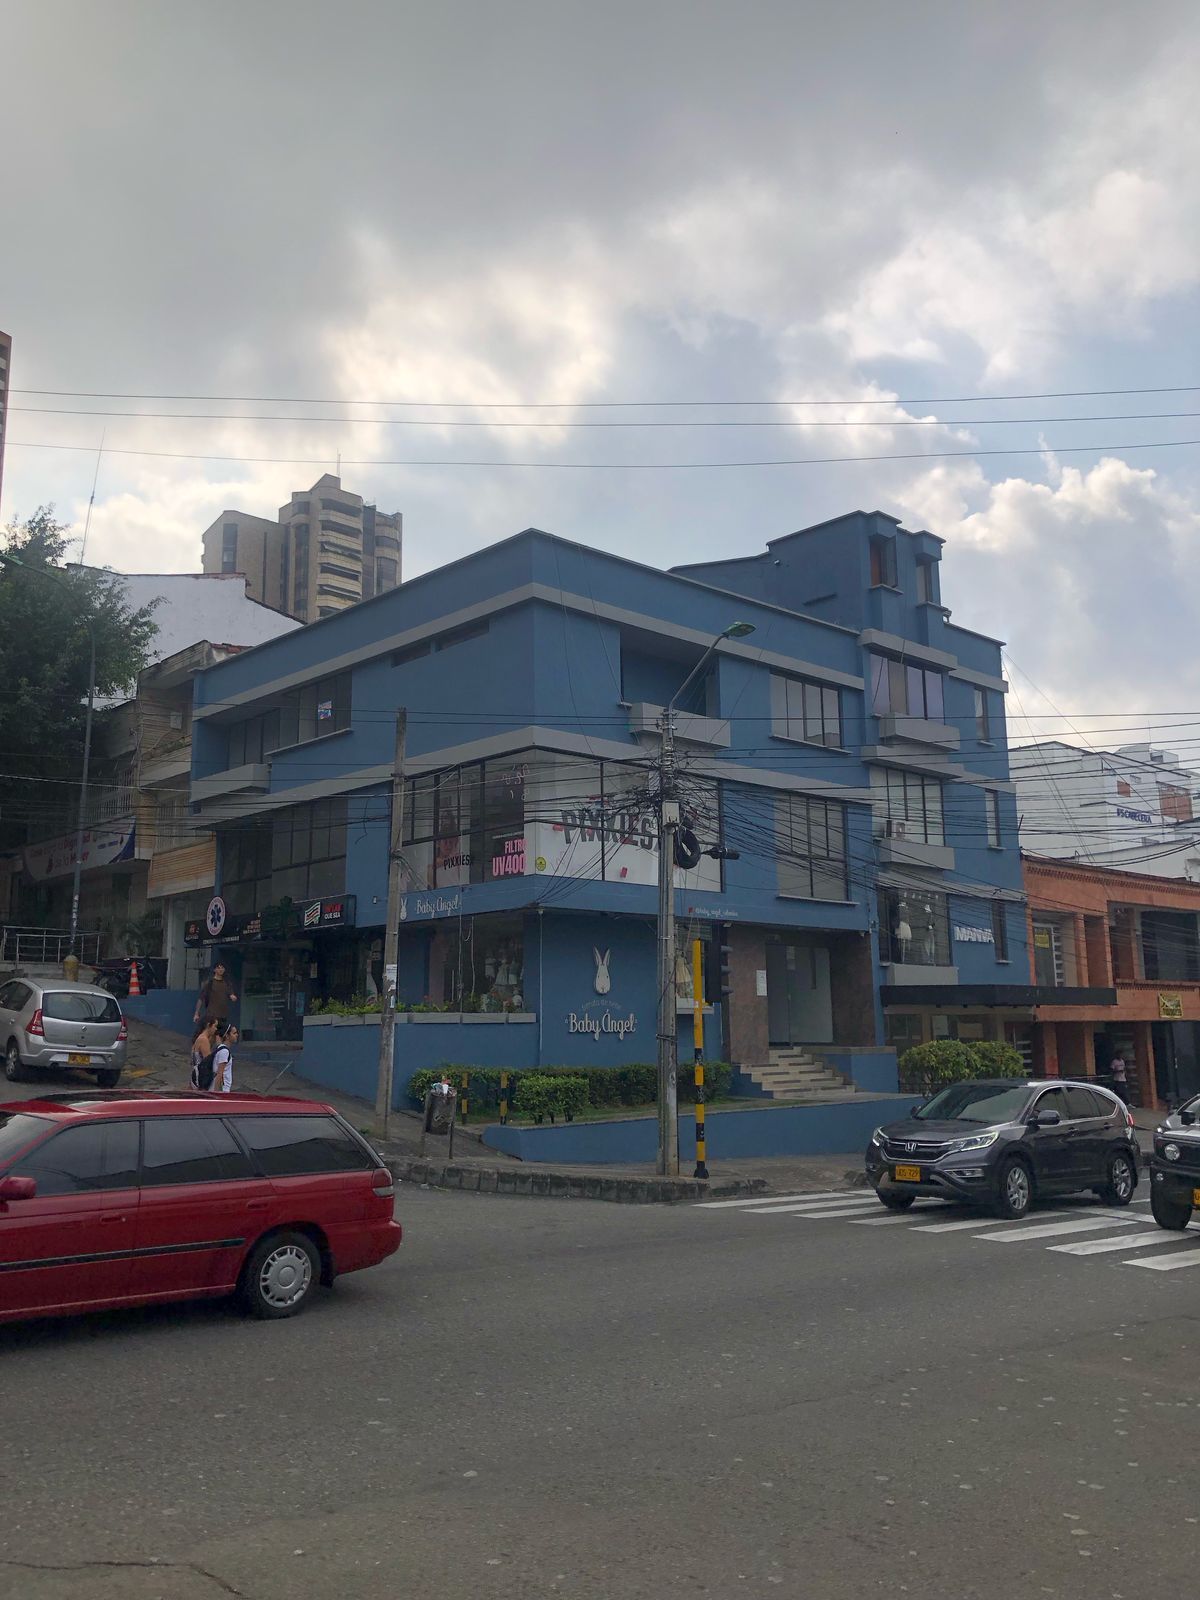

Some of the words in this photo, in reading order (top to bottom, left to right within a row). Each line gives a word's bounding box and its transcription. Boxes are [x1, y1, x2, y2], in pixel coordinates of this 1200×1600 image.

[561, 811, 654, 850] PIXXIES
[443, 854, 470, 871] PIXXIES
[492, 854, 527, 876] UV400
[416, 898, 436, 919] Baby
[568, 1012, 601, 1041] Baby
[602, 1008, 636, 1041] Ángel
